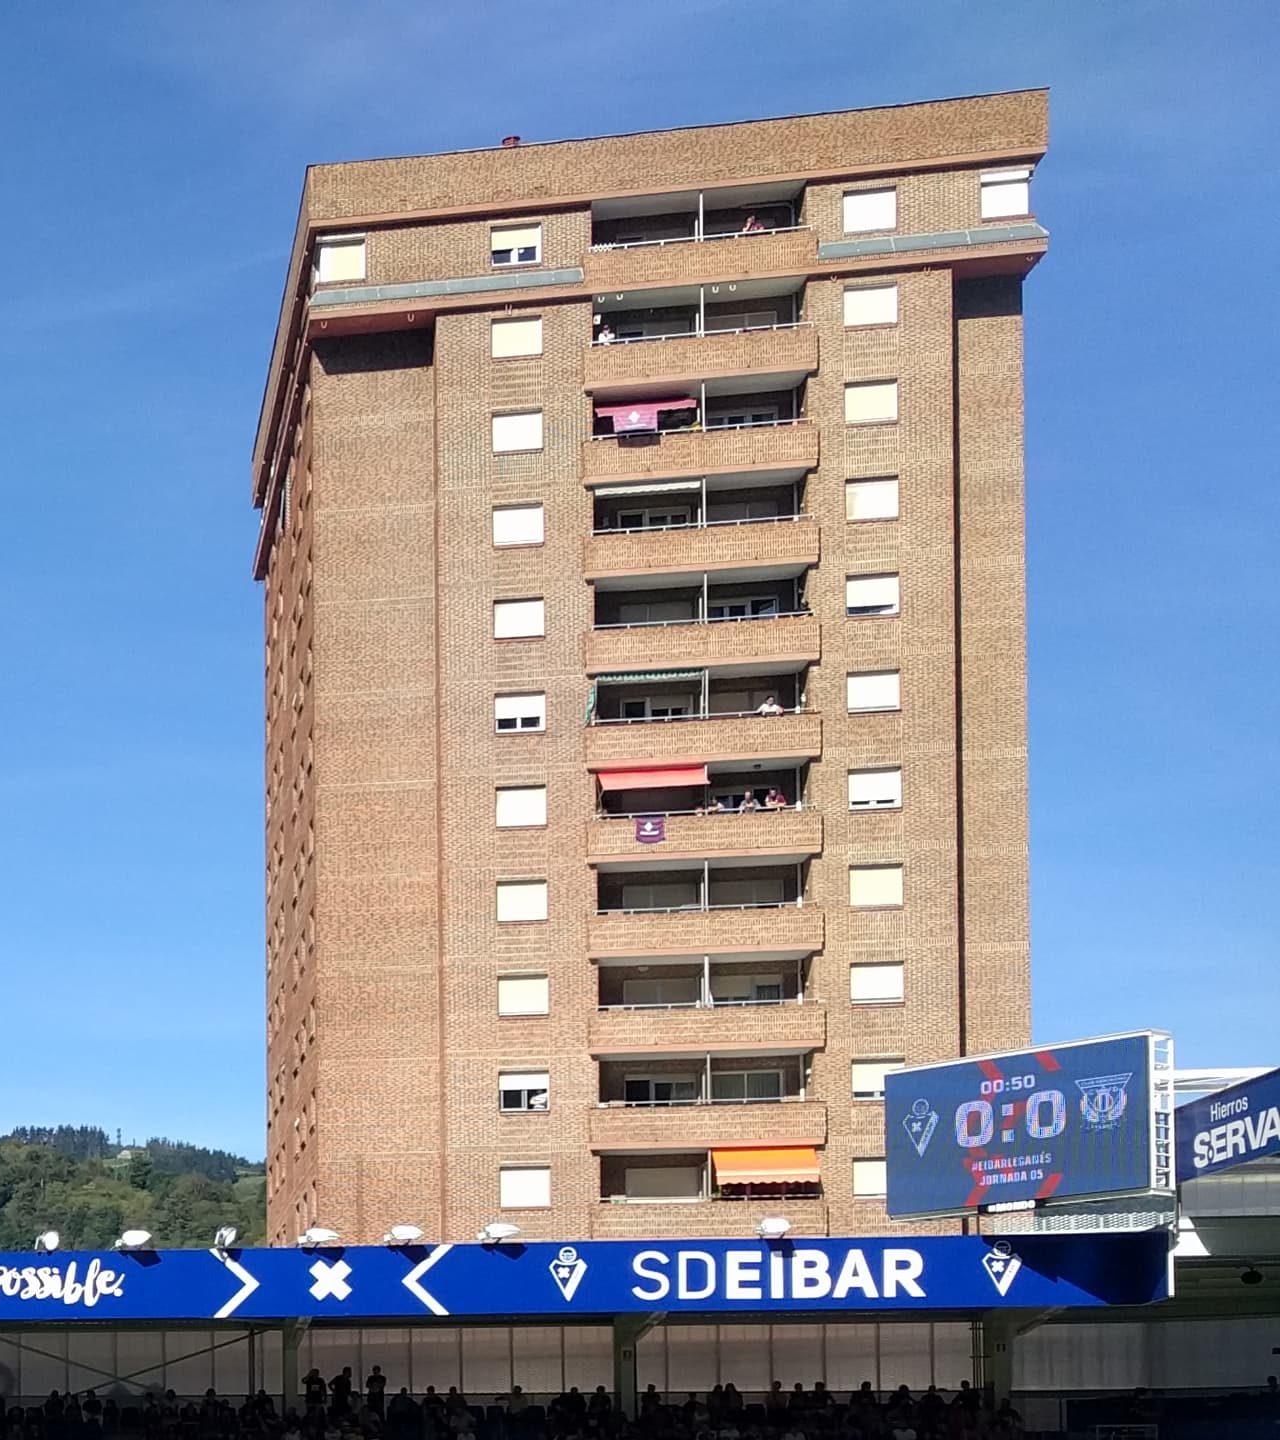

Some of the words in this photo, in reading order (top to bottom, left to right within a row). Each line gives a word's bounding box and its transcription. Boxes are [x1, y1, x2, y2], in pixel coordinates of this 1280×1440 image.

[981, 1075, 1036, 1095] 00:50
[1210, 1095, 1249, 1122] Hierros
[980, 1171, 1028, 1186] JORNADA
